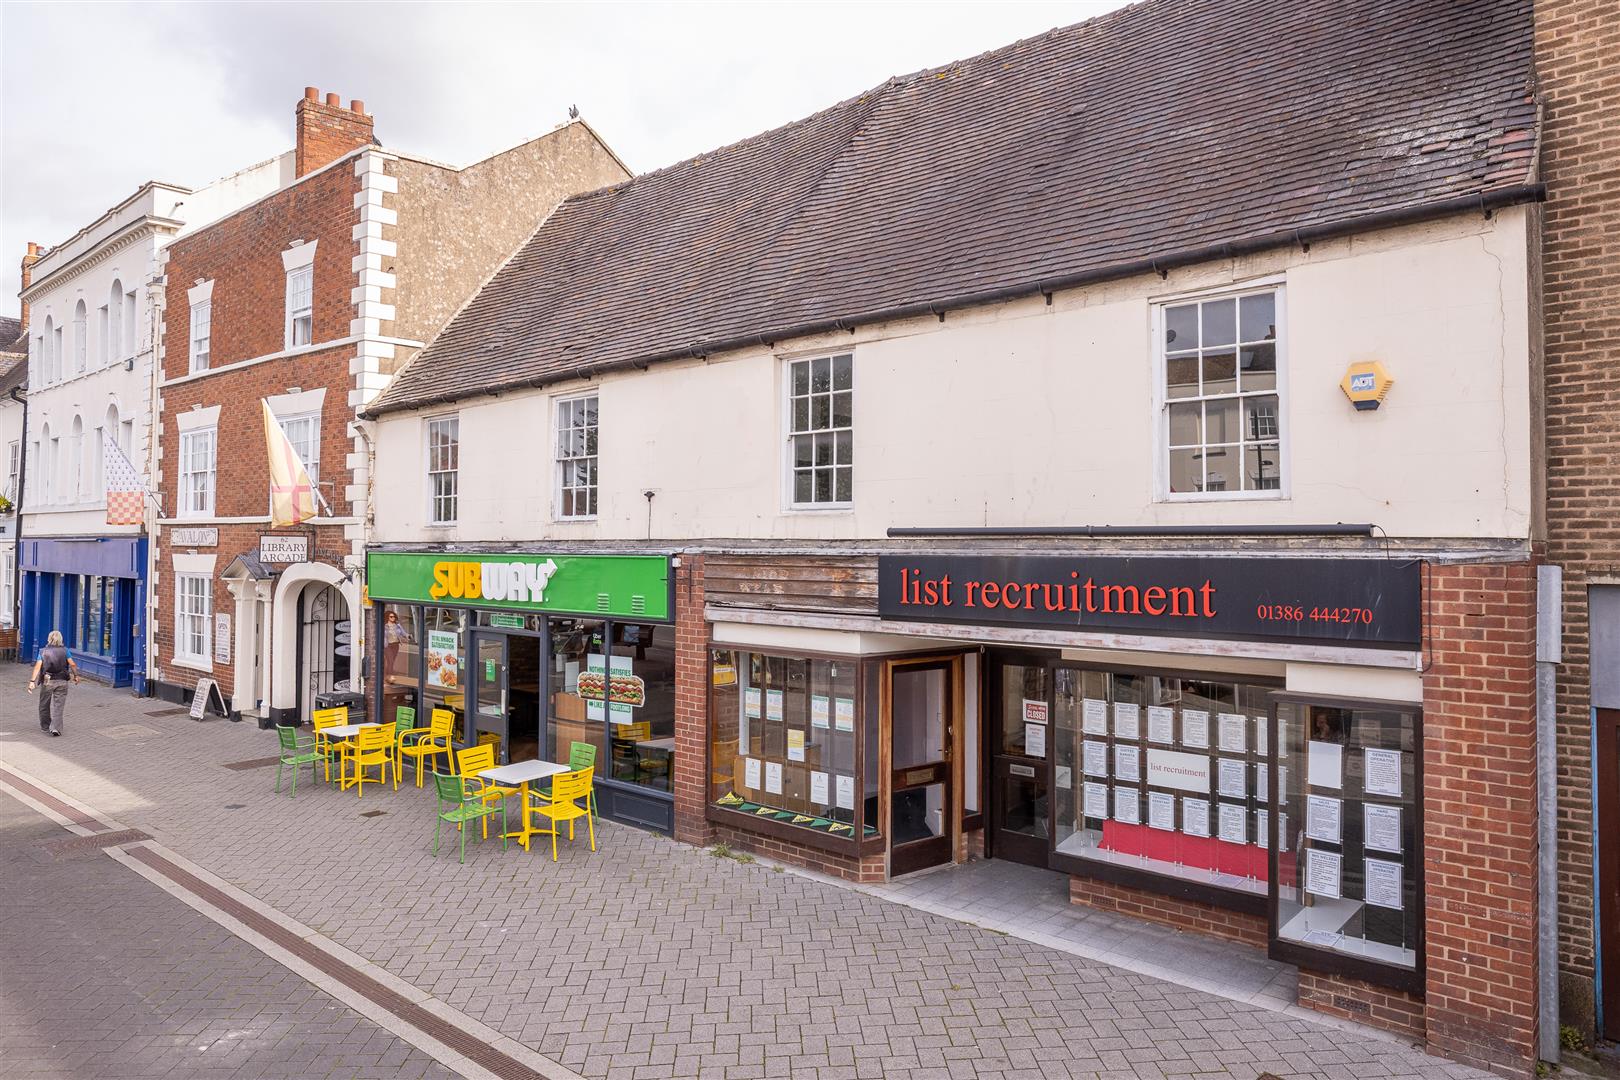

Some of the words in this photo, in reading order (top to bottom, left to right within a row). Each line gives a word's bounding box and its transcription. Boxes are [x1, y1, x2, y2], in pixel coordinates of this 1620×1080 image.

[1352, 376, 1375, 388] ADT
[261, 543, 307, 552] LIBRARY
[261, 553, 306, 562] ARCADE
[429, 558, 558, 603] SUBWAY
[900, 567, 953, 606] list
[964, 571, 1217, 618] recruitment
[1257, 604, 1304, 621] 01386
[1309, 607, 1373, 624] 444270
[1027, 710, 1046, 720] CLOSED
[1150, 762, 1161, 771] list
[1163, 766, 1207, 778] recruitment
